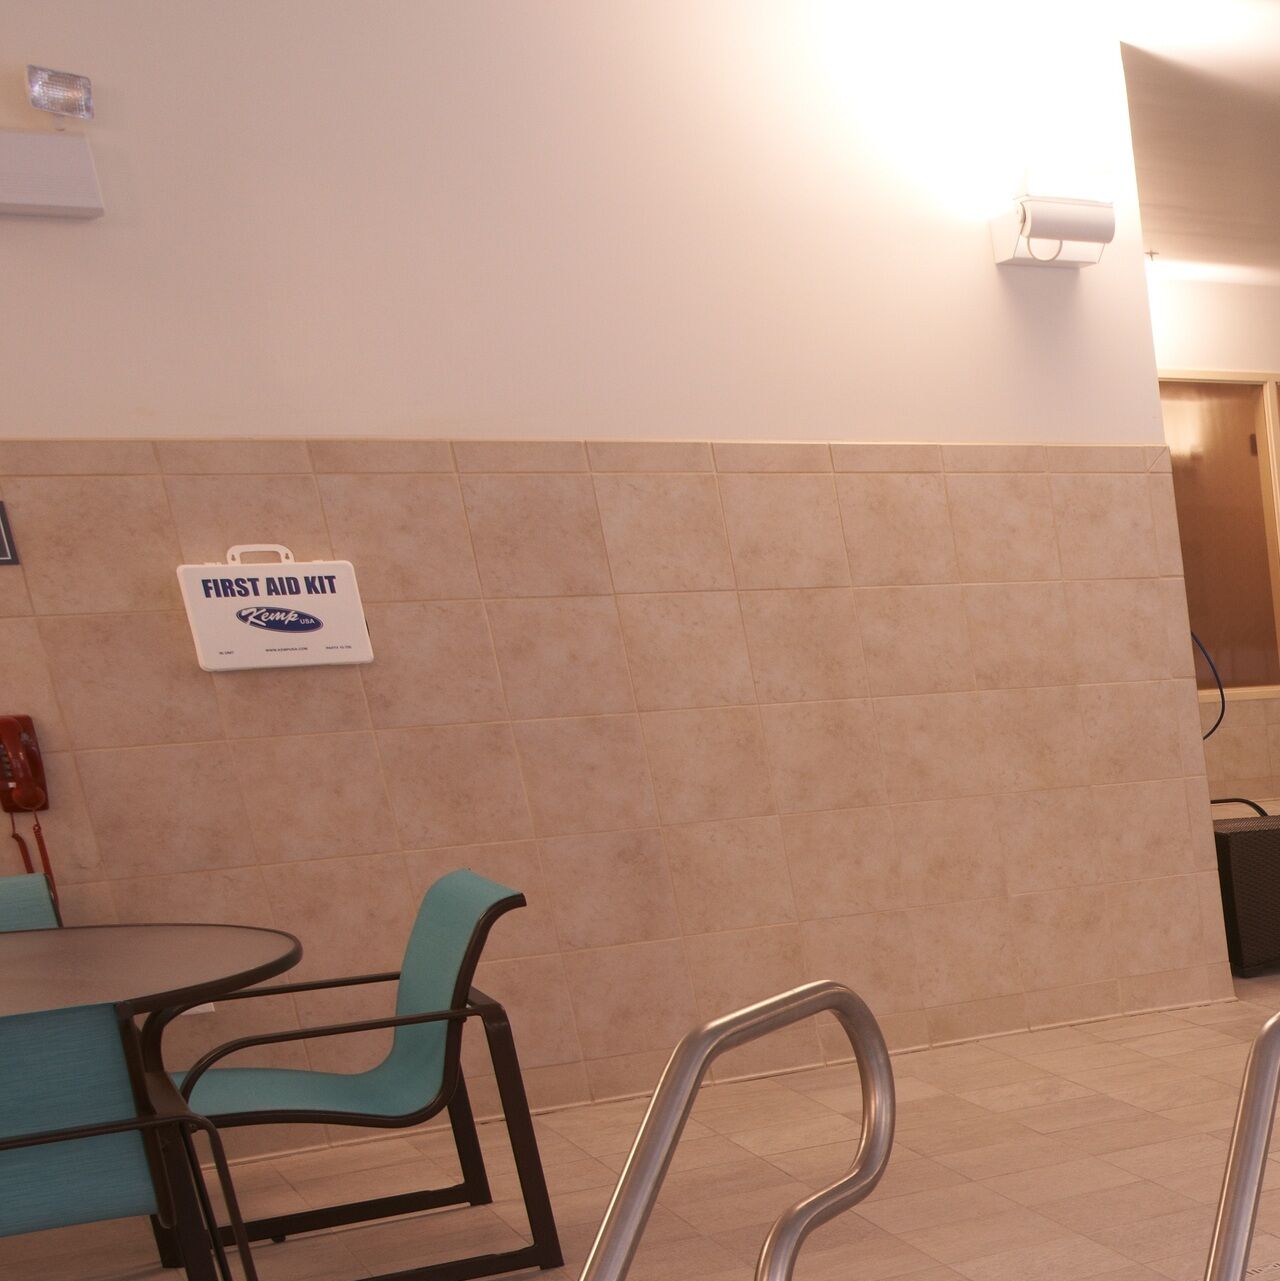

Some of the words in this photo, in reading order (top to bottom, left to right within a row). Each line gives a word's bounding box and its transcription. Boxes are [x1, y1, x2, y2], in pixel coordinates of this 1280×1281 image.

[201, 578, 260, 598] FIRST
[266, 576, 300, 596] AID
[303, 575, 337, 595] KIT
[241, 607, 300, 626] Kemp
[299, 617, 316, 625] USA
